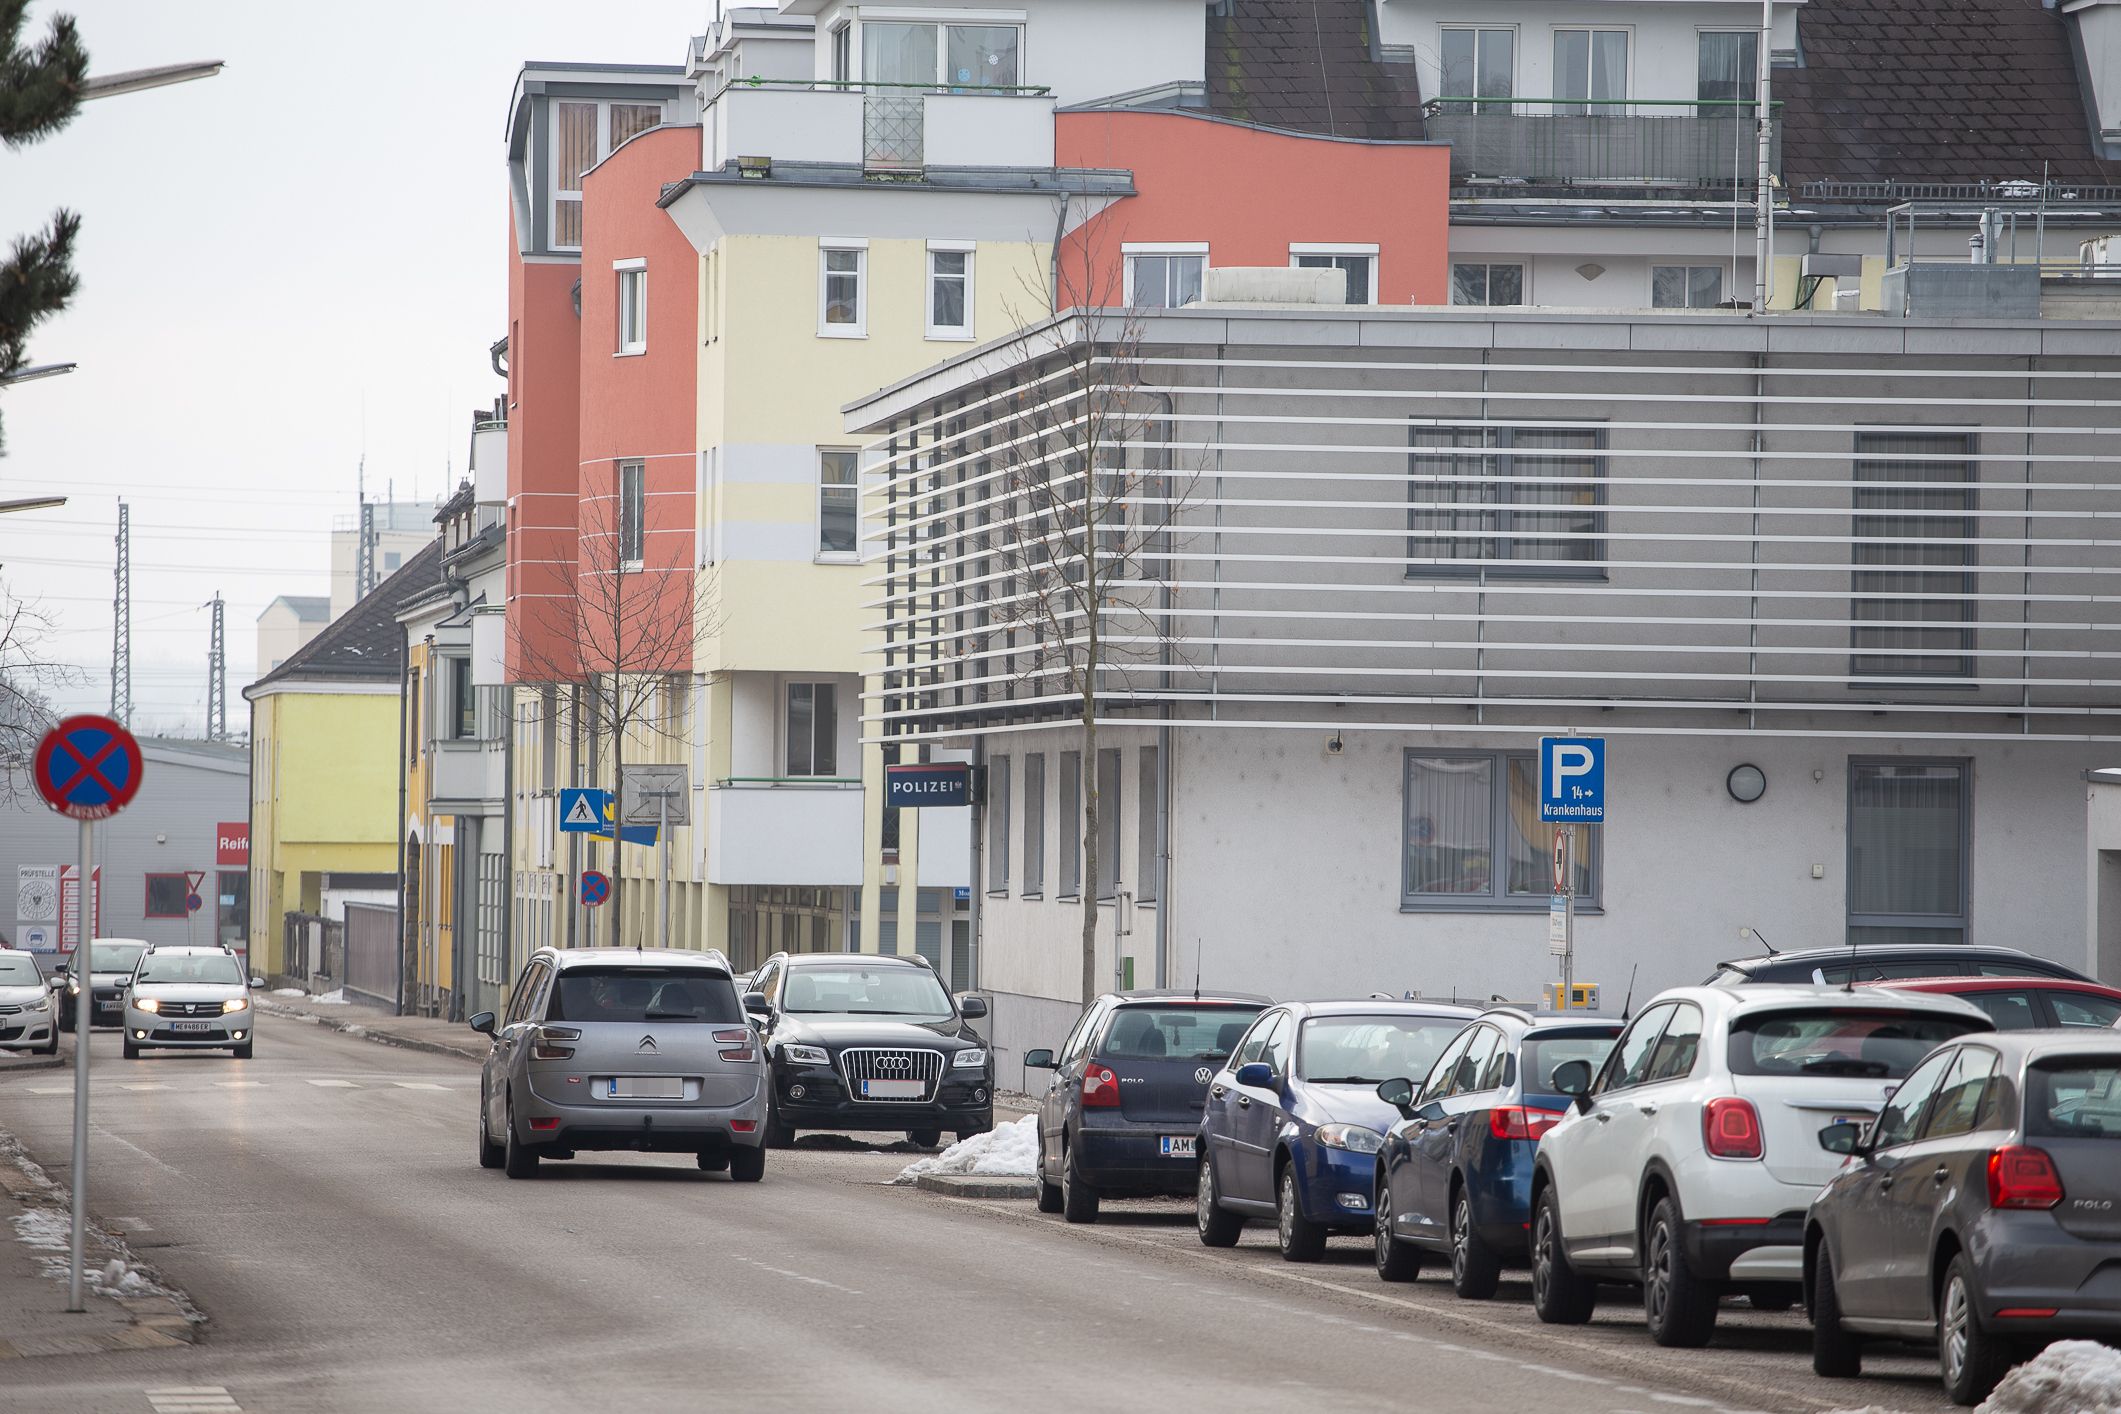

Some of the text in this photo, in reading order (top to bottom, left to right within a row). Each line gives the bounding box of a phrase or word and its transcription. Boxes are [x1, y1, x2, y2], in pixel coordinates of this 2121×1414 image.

[1552, 745, 1594, 798] P
[893, 781, 953, 793] POLIZEI
[1572, 786, 1583, 799] 14
[1544, 803, 1603, 816] Krankenhaus
[20, 869, 55, 878] PRÜFSTELLE
[1172, 1139, 1189, 1151] AM
[2073, 1199, 2112, 1210] POLO
